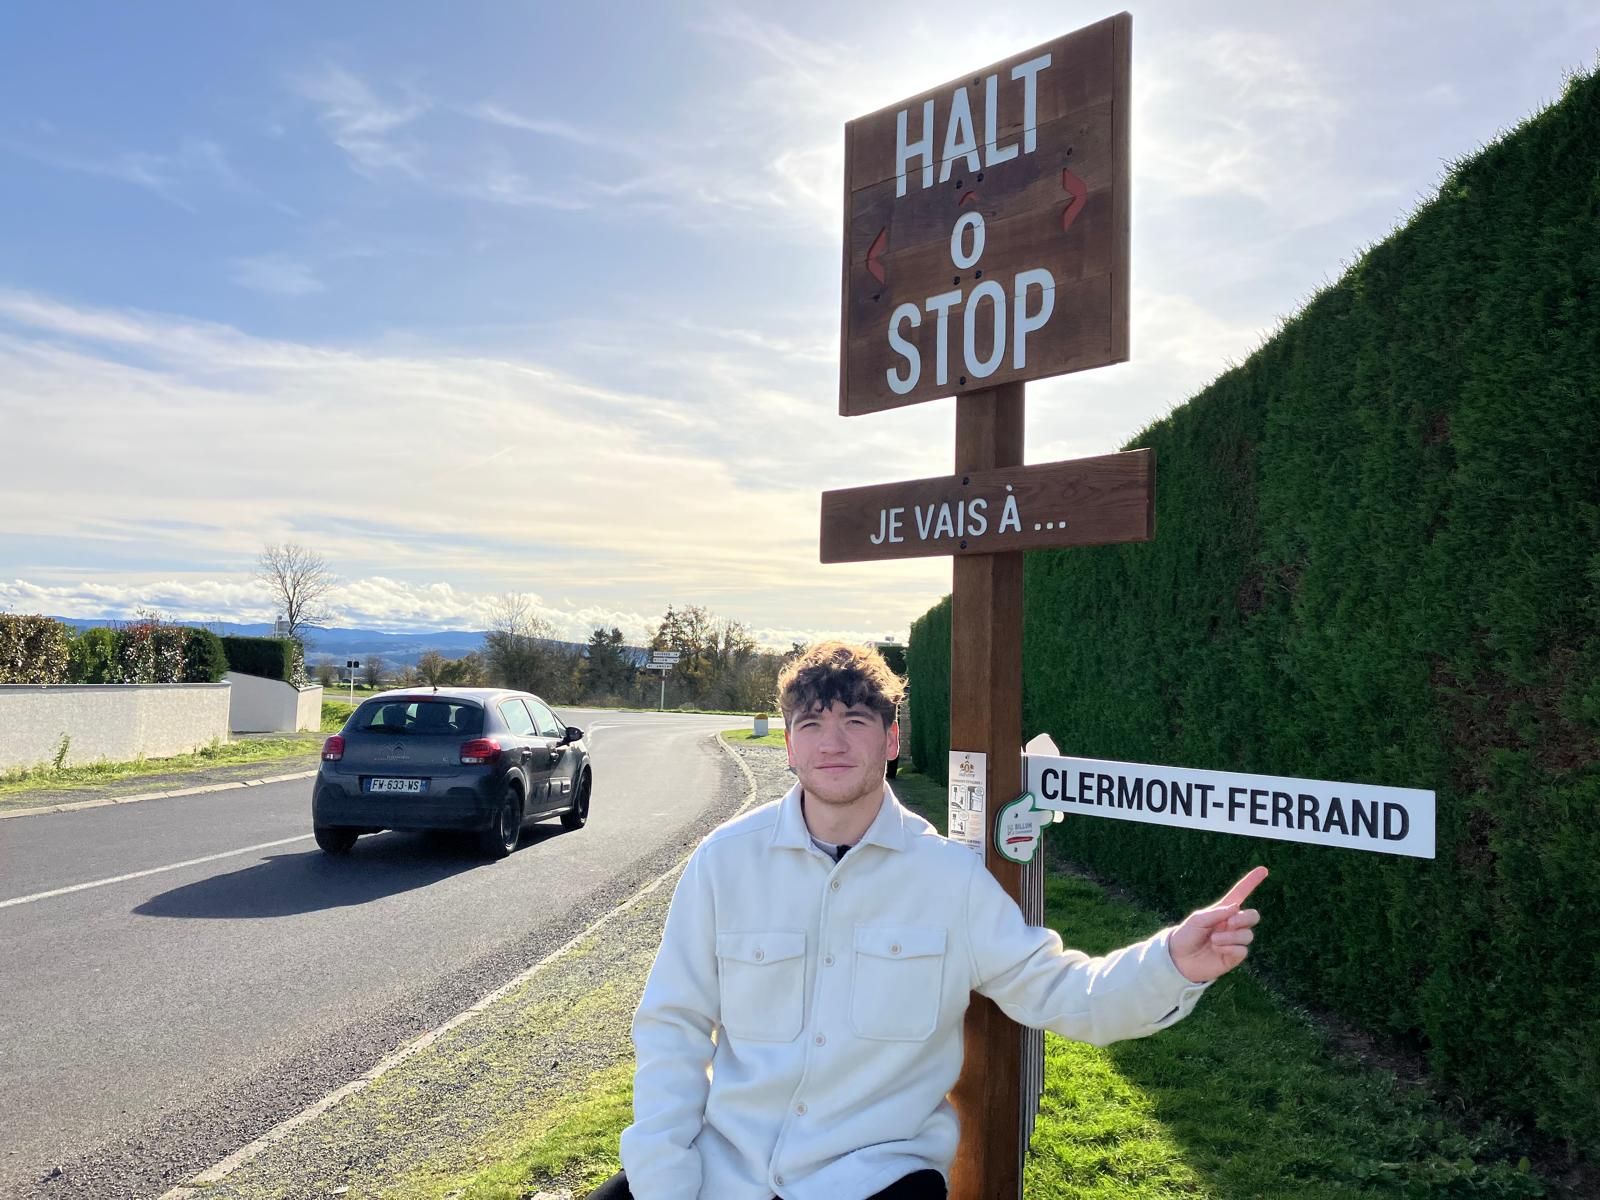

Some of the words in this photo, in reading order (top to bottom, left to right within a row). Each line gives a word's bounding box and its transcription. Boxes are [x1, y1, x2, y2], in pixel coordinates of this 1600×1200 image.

[896, 54, 1051, 198] HALT
[887, 268, 1056, 394] STOP
[870, 507, 905, 545] JE
[914, 498, 988, 540] VAIS
[998, 484, 1022, 534] À
[1041, 768, 1410, 841] CLERMONT-FERRAND
